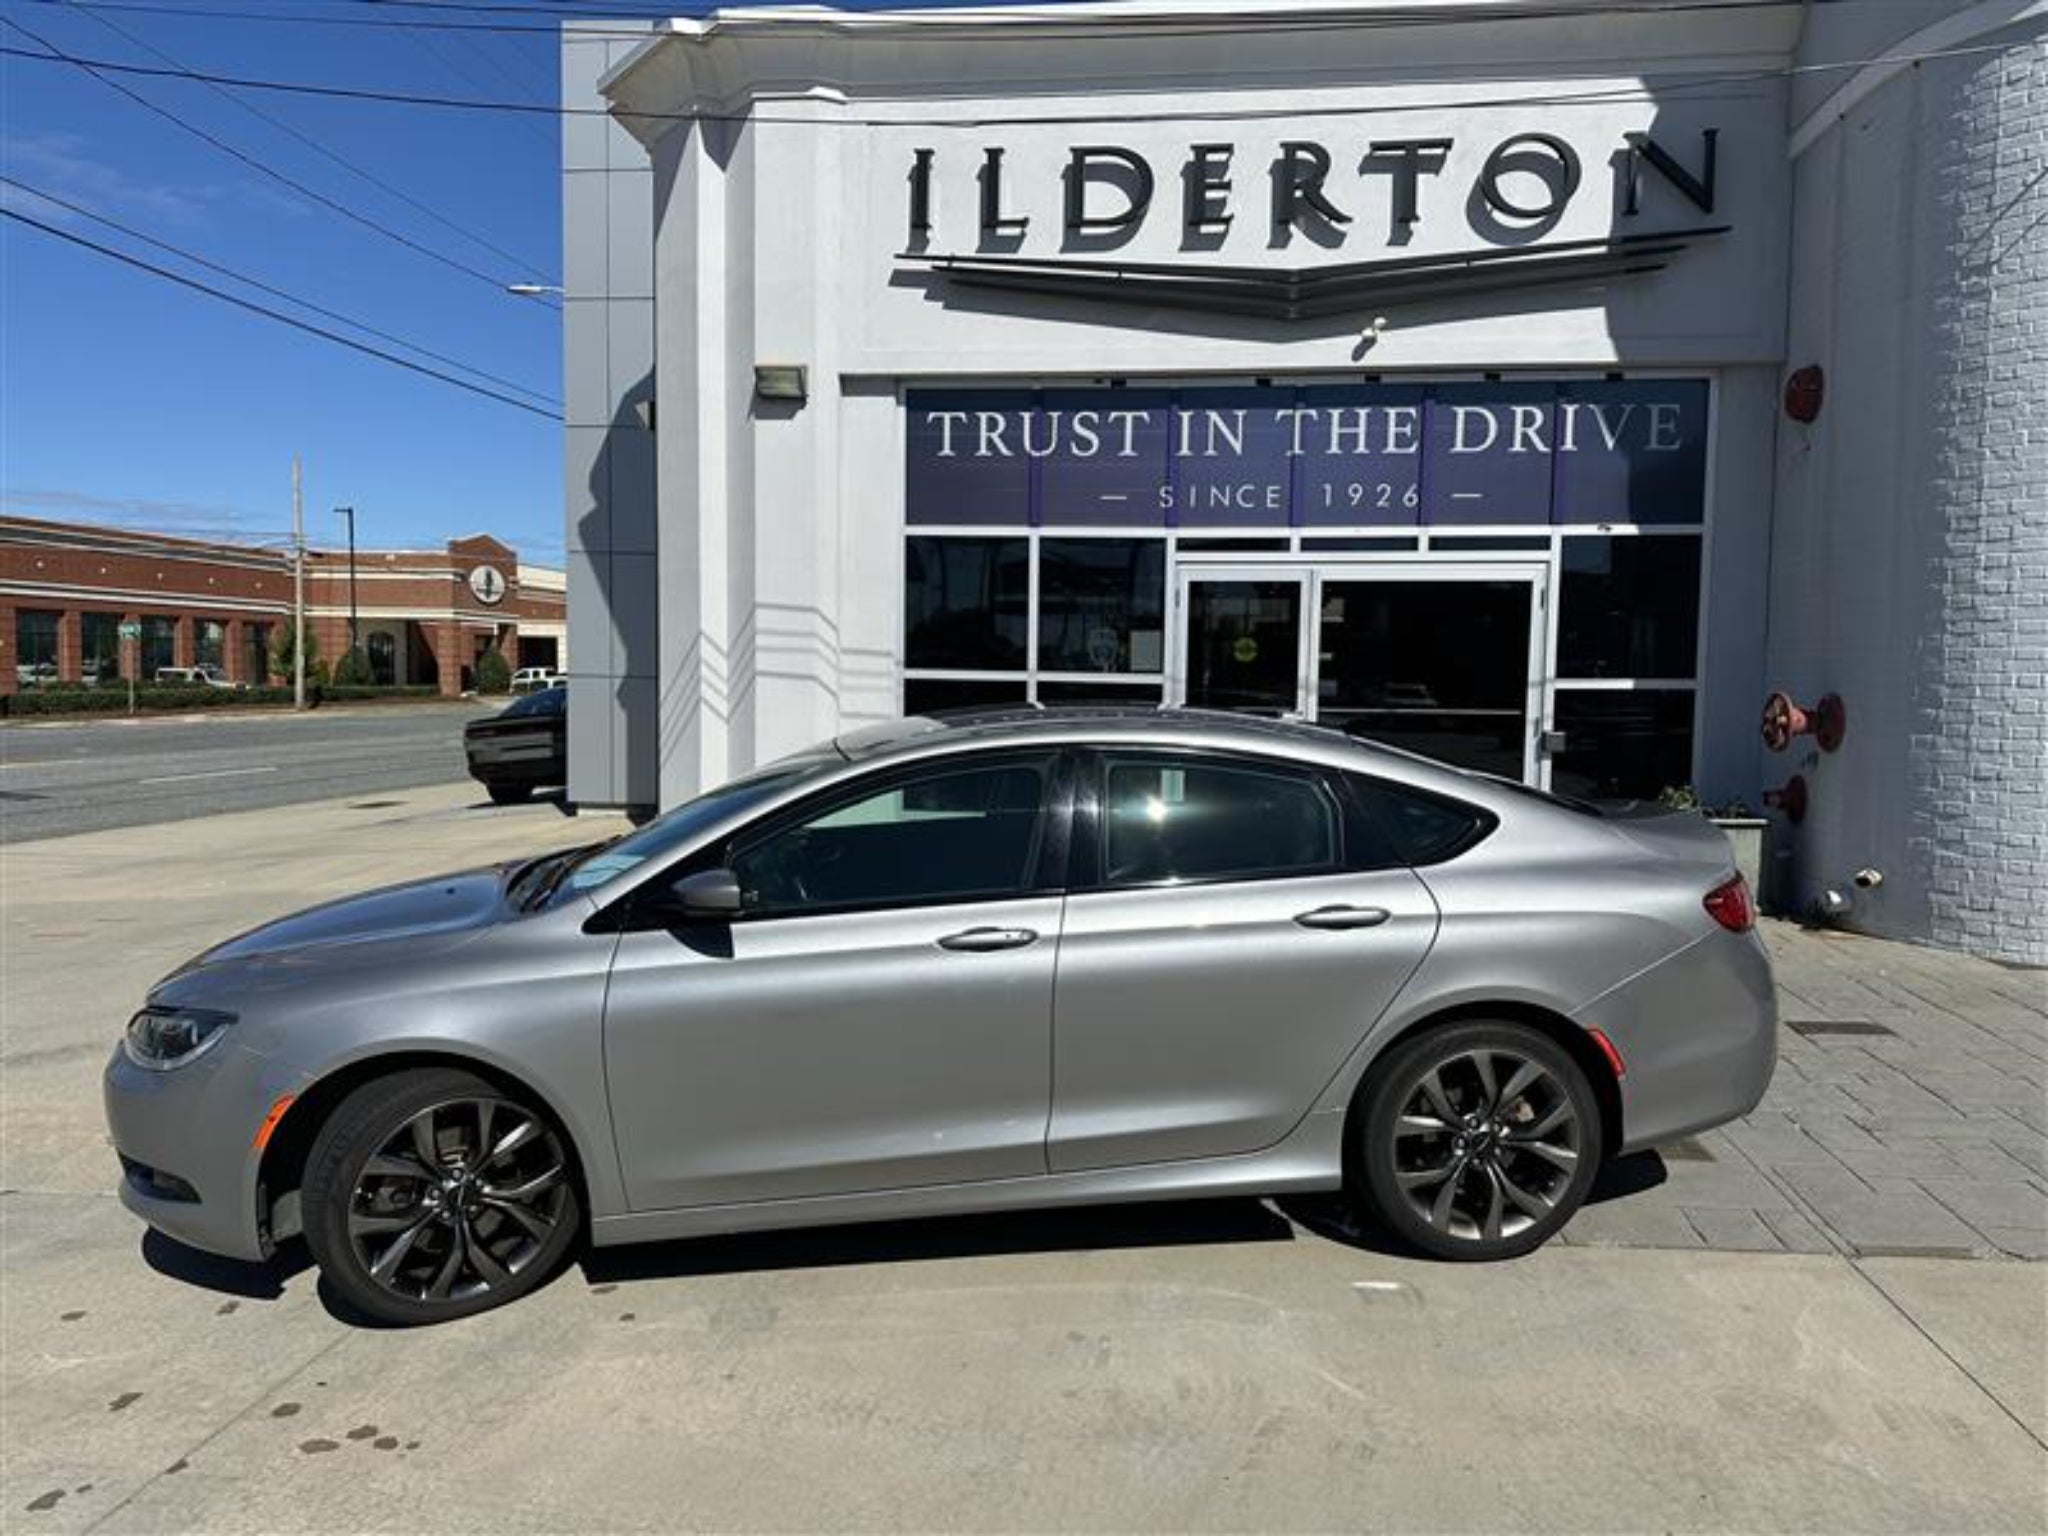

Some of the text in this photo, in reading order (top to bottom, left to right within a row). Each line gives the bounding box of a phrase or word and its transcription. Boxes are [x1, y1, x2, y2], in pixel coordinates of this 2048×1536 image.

[911, 127, 1719, 231] ILDERTON
[926, 402, 1683, 457] TRUST IN THE DRIVE
[1158, 482, 1419, 509] SINCE 1926
